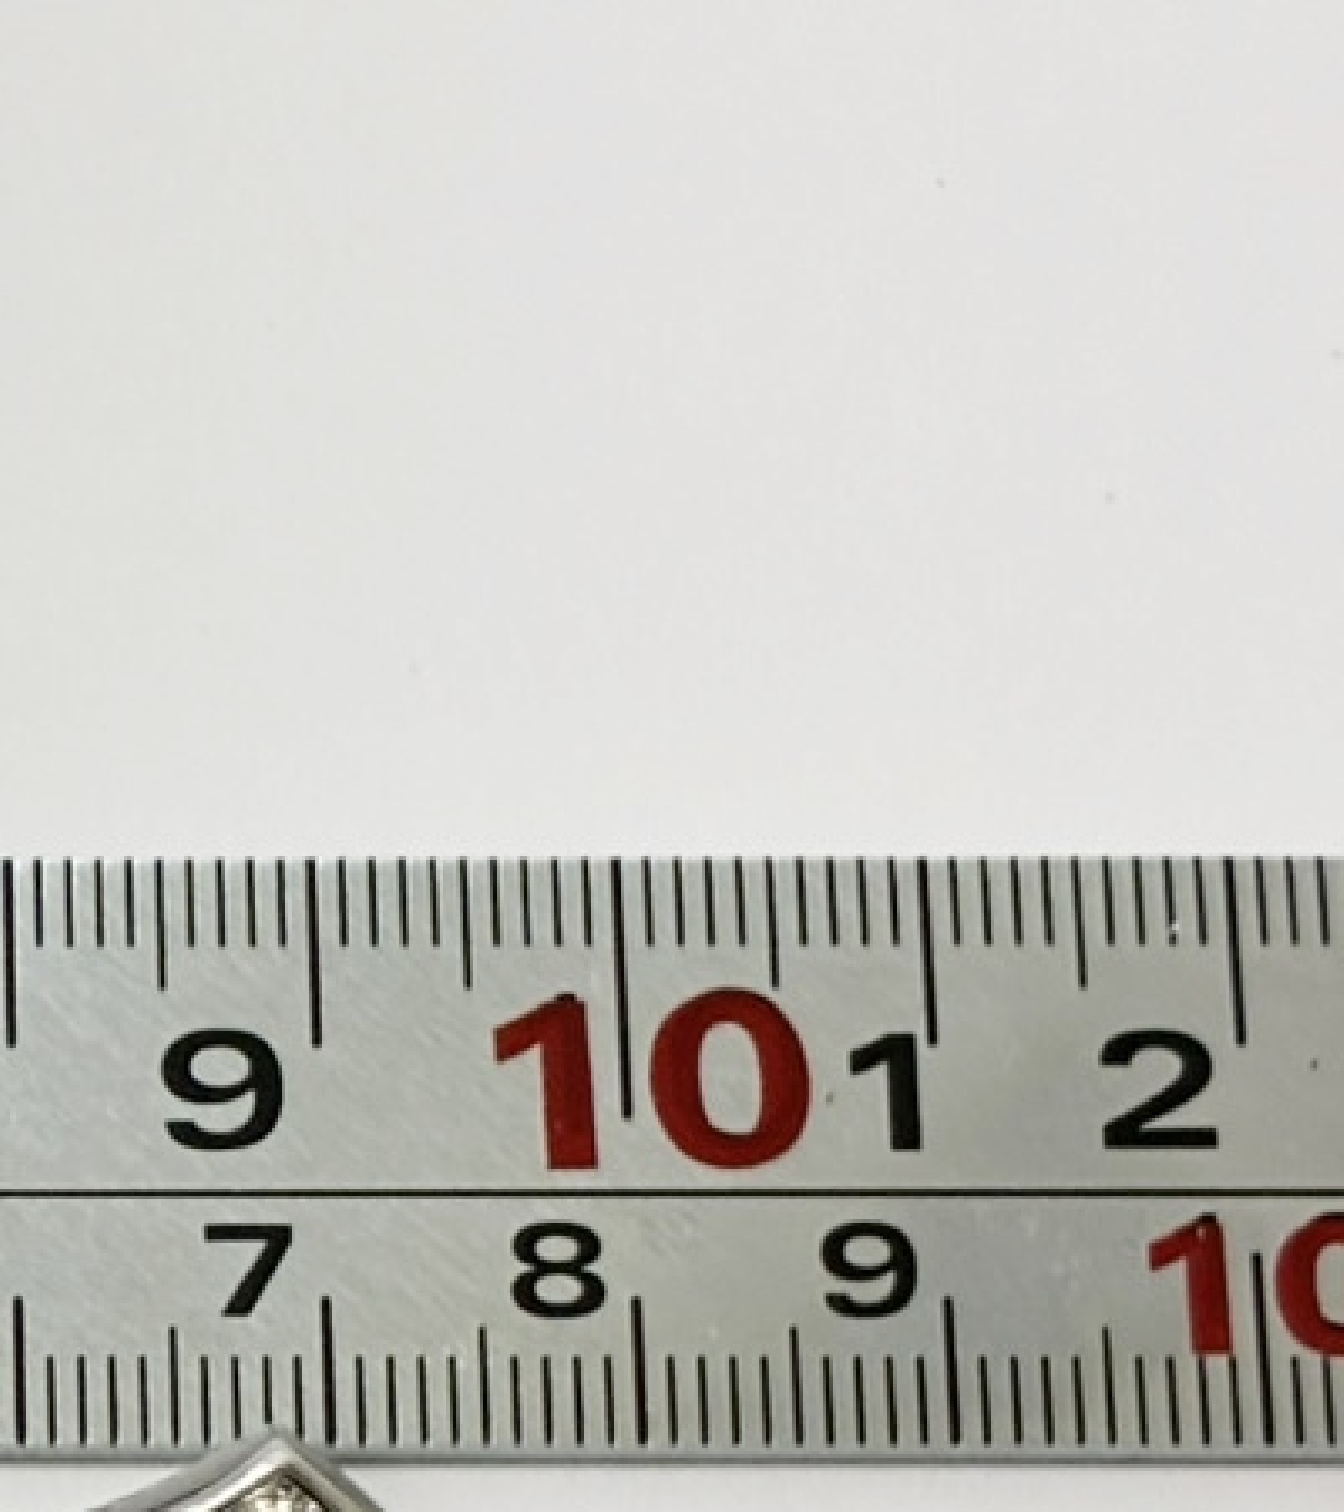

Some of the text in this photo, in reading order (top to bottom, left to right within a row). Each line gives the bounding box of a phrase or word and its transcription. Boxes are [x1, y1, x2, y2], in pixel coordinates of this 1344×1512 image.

[161, 1028, 284, 1151] 9
[492, 987, 812, 1170] 10
[848, 1031, 923, 1152] 1
[1097, 1028, 1219, 1149] 2
[203, 1223, 293, 1318] 7
[510, 1220, 605, 1318] 8
[819, 1220, 918, 1318] 9
